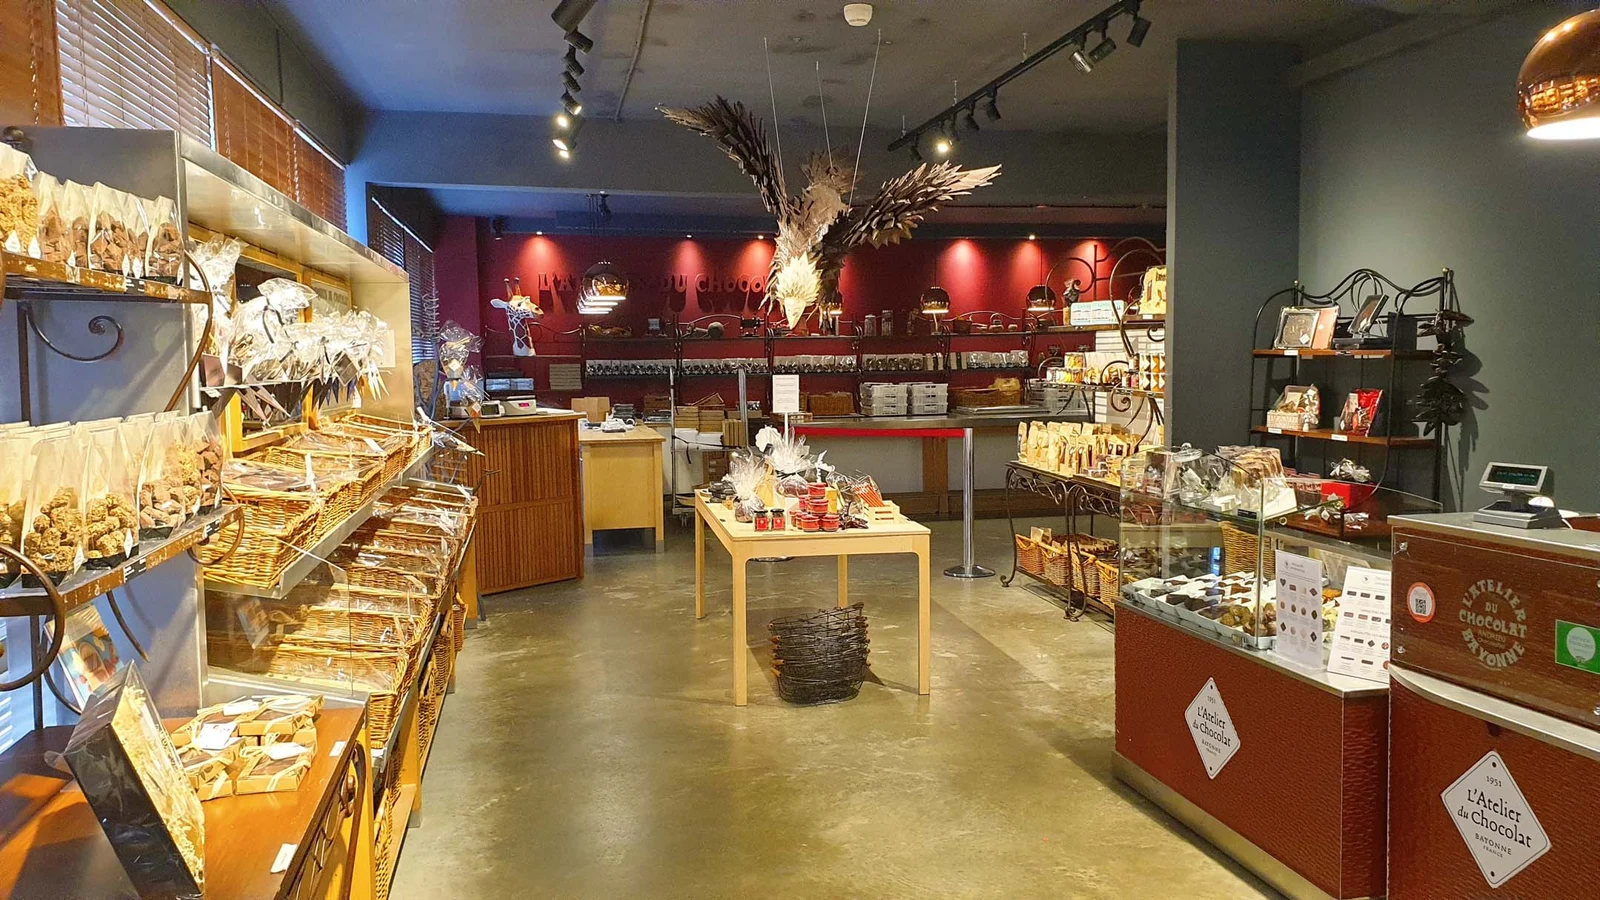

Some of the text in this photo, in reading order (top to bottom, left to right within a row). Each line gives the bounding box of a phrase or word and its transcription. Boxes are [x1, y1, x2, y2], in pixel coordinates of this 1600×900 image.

[695, 273, 767, 293] CHOCO
[1462, 579, 1526, 622] L'ATELIER
[1485, 602, 1498, 613] DU
[1459, 609, 1527, 638] CHOCOLAT
[1461, 628, 1525, 667] BAYONNE
[1197, 706, 1226, 730] L'Atelier
[1200, 722, 1231, 748] Chocolat
[1486, 776, 1502, 787] 1951
[1467, 789, 1521, 823] L'Atelier
[1457, 806, 1532, 848] du Chocolat
[1475, 833, 1512, 855] BAYONNE
[1483, 845, 1504, 858] FRANCE
